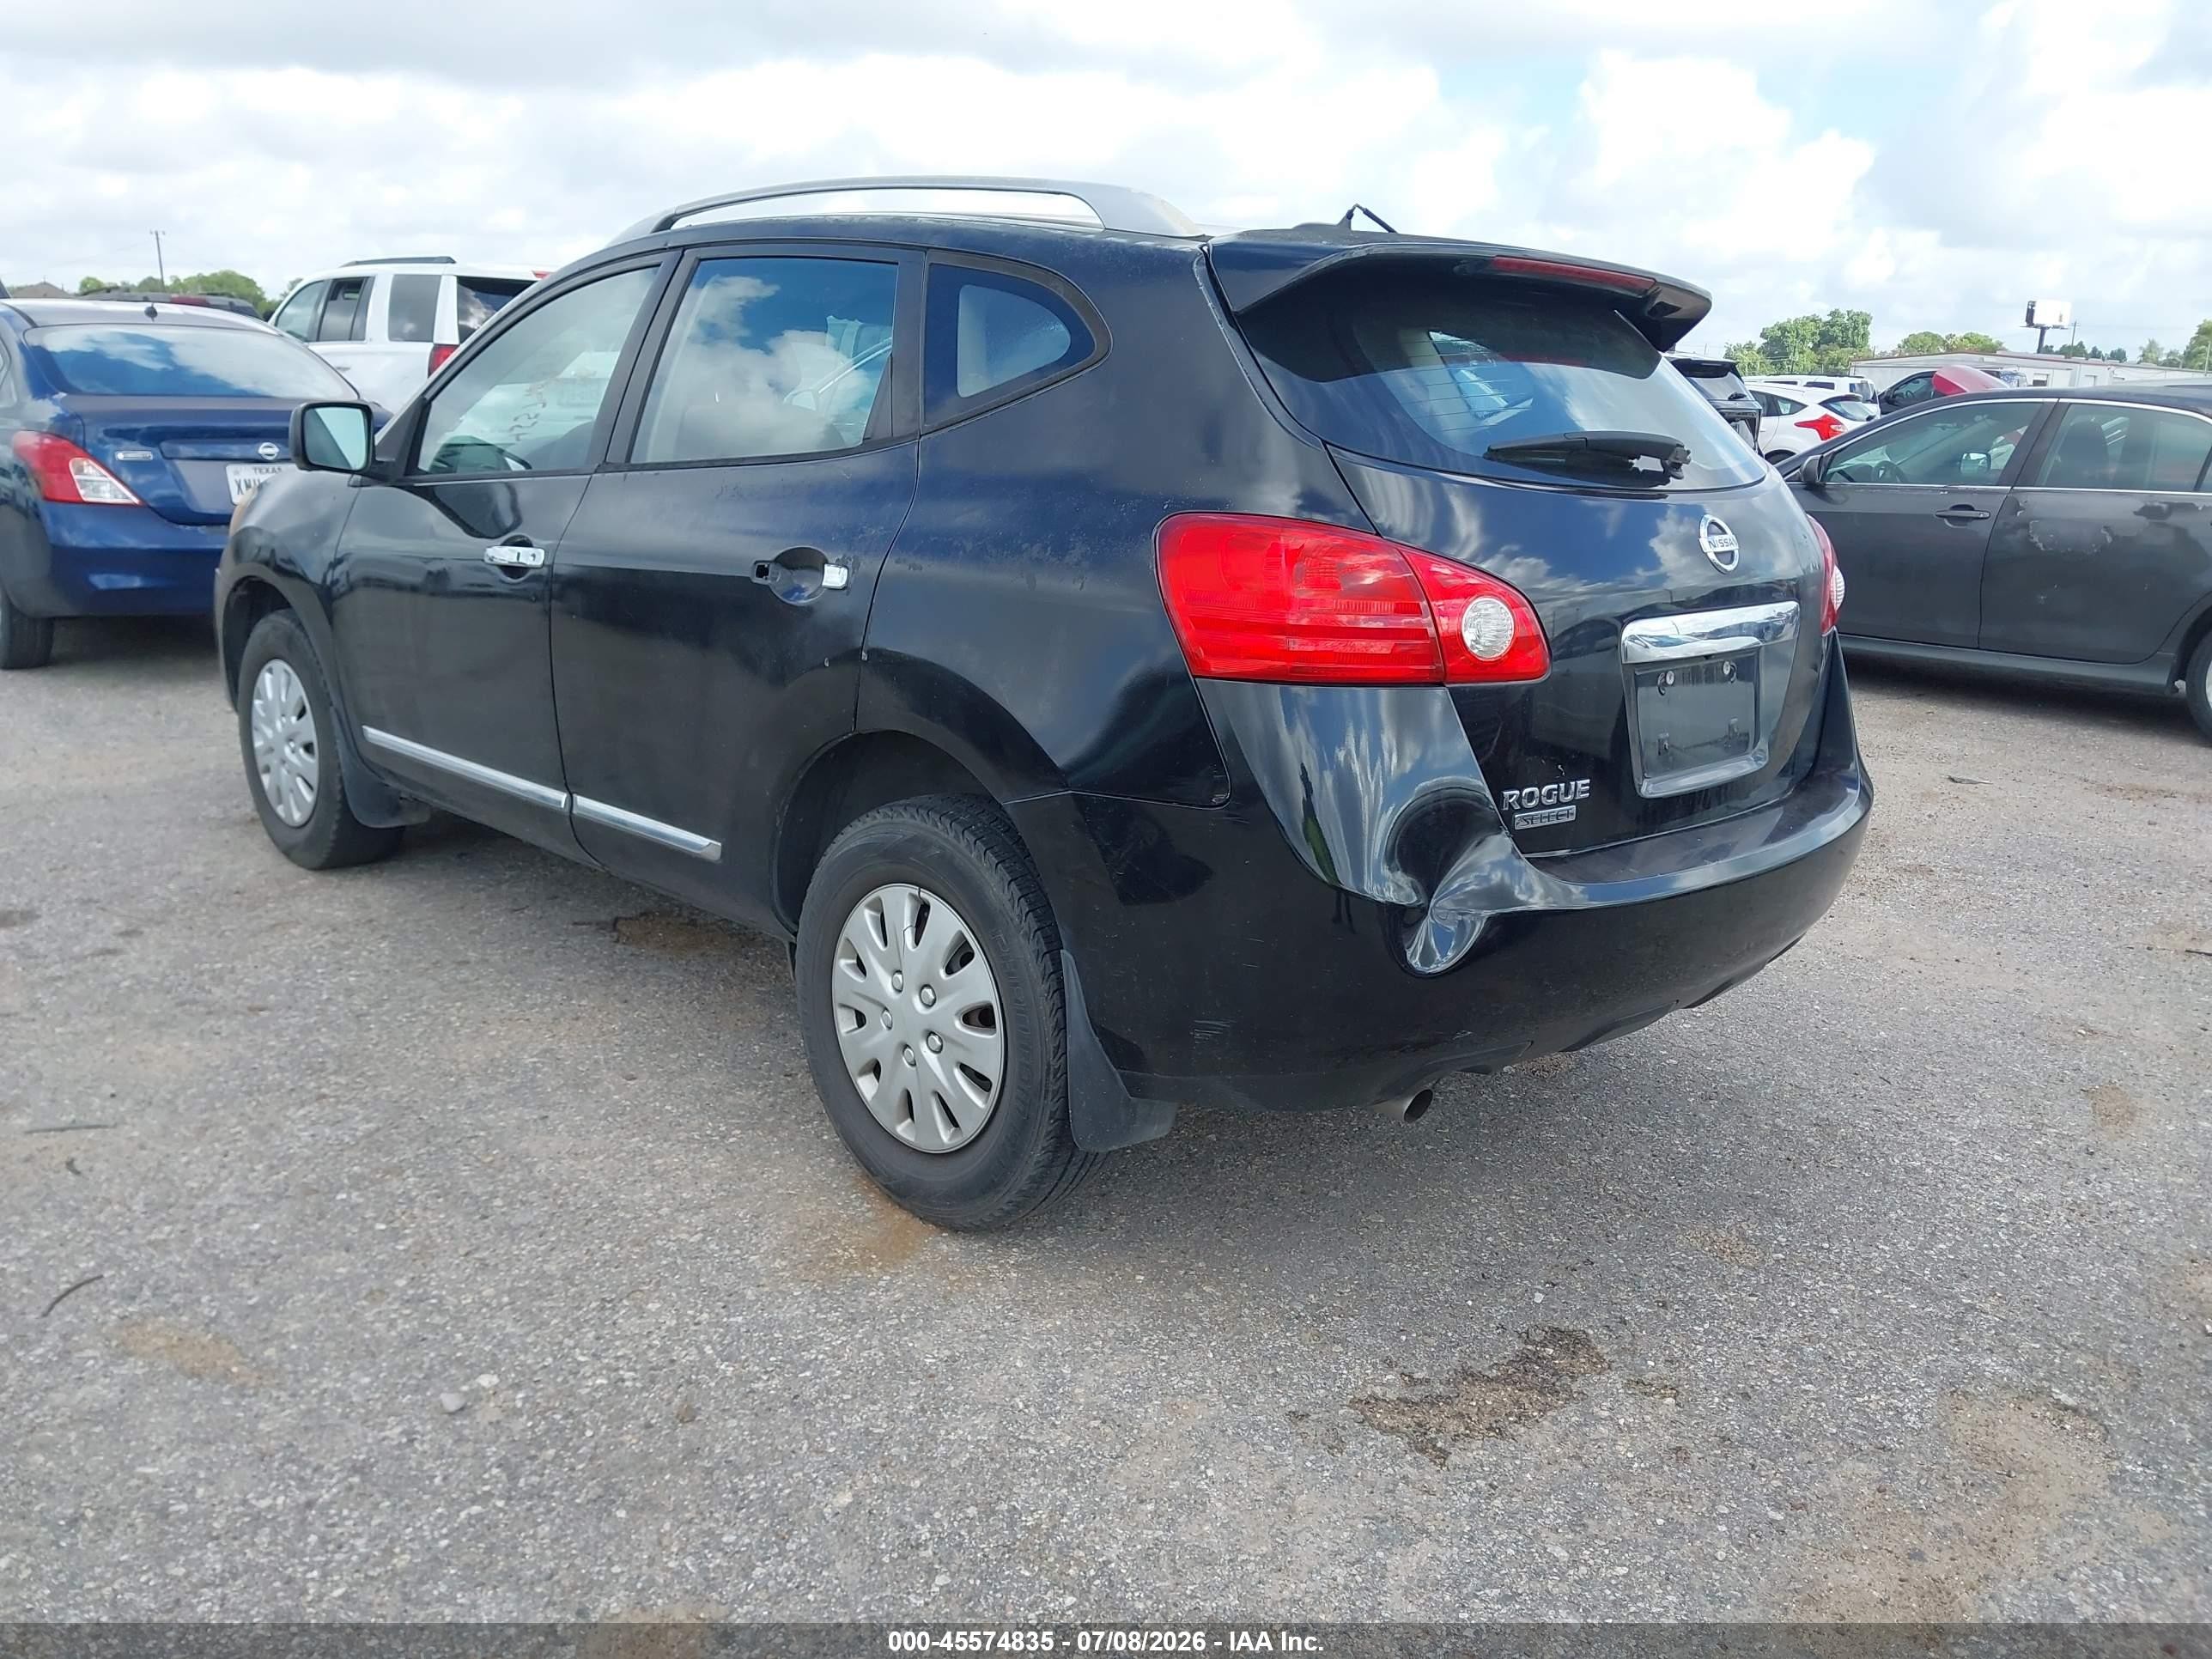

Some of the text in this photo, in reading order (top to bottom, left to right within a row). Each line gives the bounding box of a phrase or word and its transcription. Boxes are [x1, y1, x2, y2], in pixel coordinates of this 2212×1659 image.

[252, 466, 282, 475] TEXAS
[1708, 537, 1739, 550] NISSAN
[1501, 779, 1590, 811] ROGUE
[1518, 807, 1575, 827] SELECT
